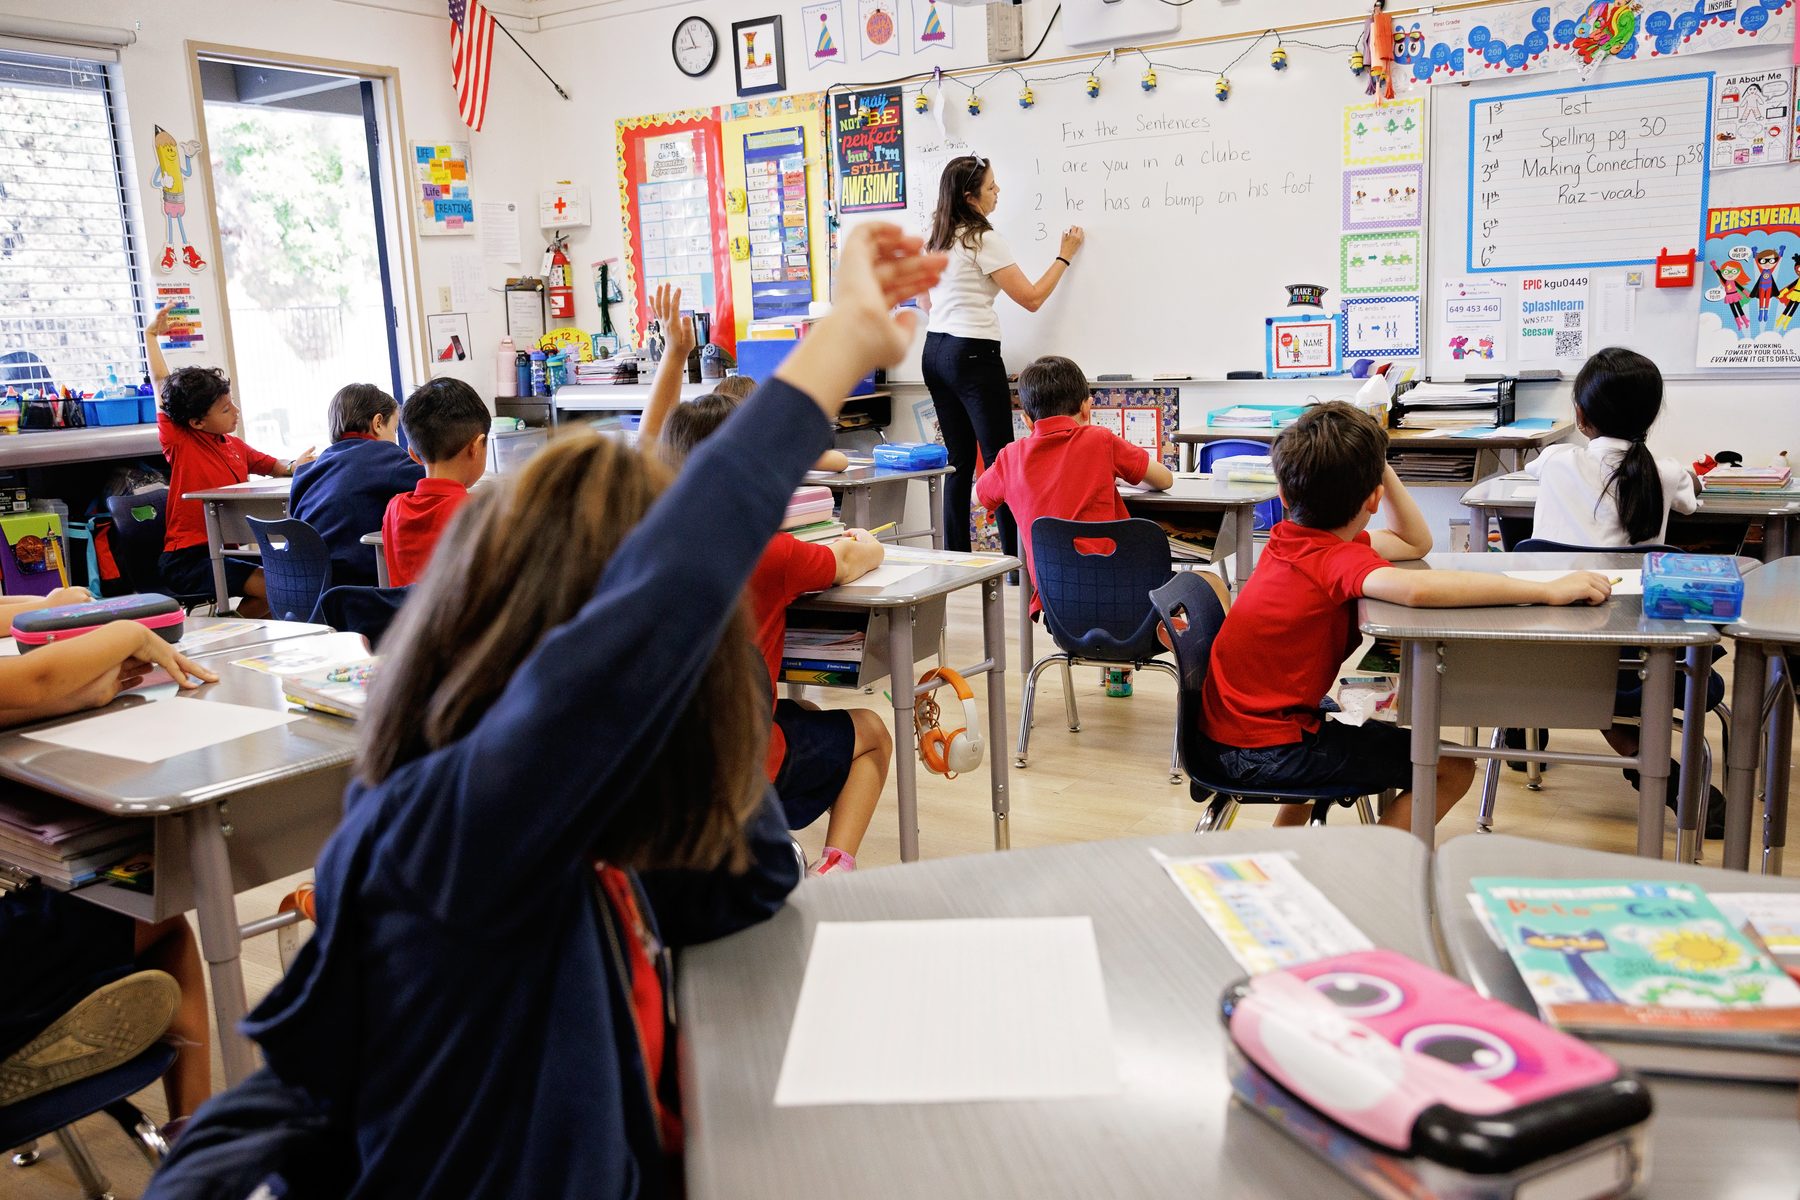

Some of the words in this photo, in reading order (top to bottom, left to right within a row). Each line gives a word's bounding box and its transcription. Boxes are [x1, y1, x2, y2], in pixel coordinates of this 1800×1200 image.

[1708, 0, 1733, 12] INSPIRE
[1473, 34, 1486, 42] 150
[1528, 39, 1544, 47] 325
[743, 31, 773, 69] L
[1487, 48, 1502, 56] 200
[1509, 52, 1524, 60] 250
[1739, 74, 1765, 84] About
[848, 95, 857, 116] I
[860, 93, 889, 115] may
[1556, 94, 1593, 116] Test
[840, 118, 862, 132] NOT
[867, 109, 898, 127] BE
[1062, 121, 1085, 142] Fix
[1094, 120, 1118, 136] the
[1136, 111, 1211, 132] Sentences
[841, 127, 898, 155] perfect
[1482, 128, 1503, 152] 2nd
[1540, 126, 1595, 154] Spelling
[1639, 116, 1667, 137] 30
[847, 149, 868, 164] but
[874, 145, 901, 162] I'm
[1062, 160, 1088, 173] are
[1102, 160, 1129, 181] you
[1143, 157, 1159, 168] in
[1174, 153, 1185, 167] a
[1201, 140, 1252, 164] clube
[1481, 159, 1499, 183] 3rd
[1521, 156, 1581, 188] Making
[1586, 148, 1667, 173] Connections
[425, 187, 440, 197] Life
[841, 171, 904, 207] AWESOME!
[1034, 192, 1043, 211] 2
[1064, 186, 1085, 211] he
[1103, 188, 1131, 212] has
[1141, 196, 1151, 209] a
[1164, 181, 1204, 215] bump
[1218, 190, 1238, 204] on
[1248, 178, 1269, 198] his
[1281, 171, 1315, 195] foot
[435, 203, 472, 214] CREATING
[1482, 191, 1500, 210] 4th
[1482, 218, 1499, 238] 5th
[1710, 206, 1800, 234] PERSEVERA
[1034, 222, 1048, 241] 3
[1480, 245, 1497, 267] 6th
[1293, 287, 1312, 296] MAKE
[1312, 288, 1320, 297] IT
[1523, 279, 1542, 291] EPIC
[1544, 277, 1588, 291] kgu0449
[1292, 294, 1320, 304] HAPPEN
[1449, 305, 1464, 313] 649
[1466, 304, 1481, 313] 453
[1483, 304, 1498, 312] 460
[1522, 299, 1585, 314] Splashlearn
[549, 336, 558, 344] 11
[560, 332, 571, 340] 12
[1522, 327, 1554, 337] Seesaw
[583, 342, 589, 350] 2
[1303, 338, 1324, 347] NAME
[586, 354, 593, 362] 3
[1506, 898, 1592, 918] Pete
[1625, 903, 1699, 920] Cat
